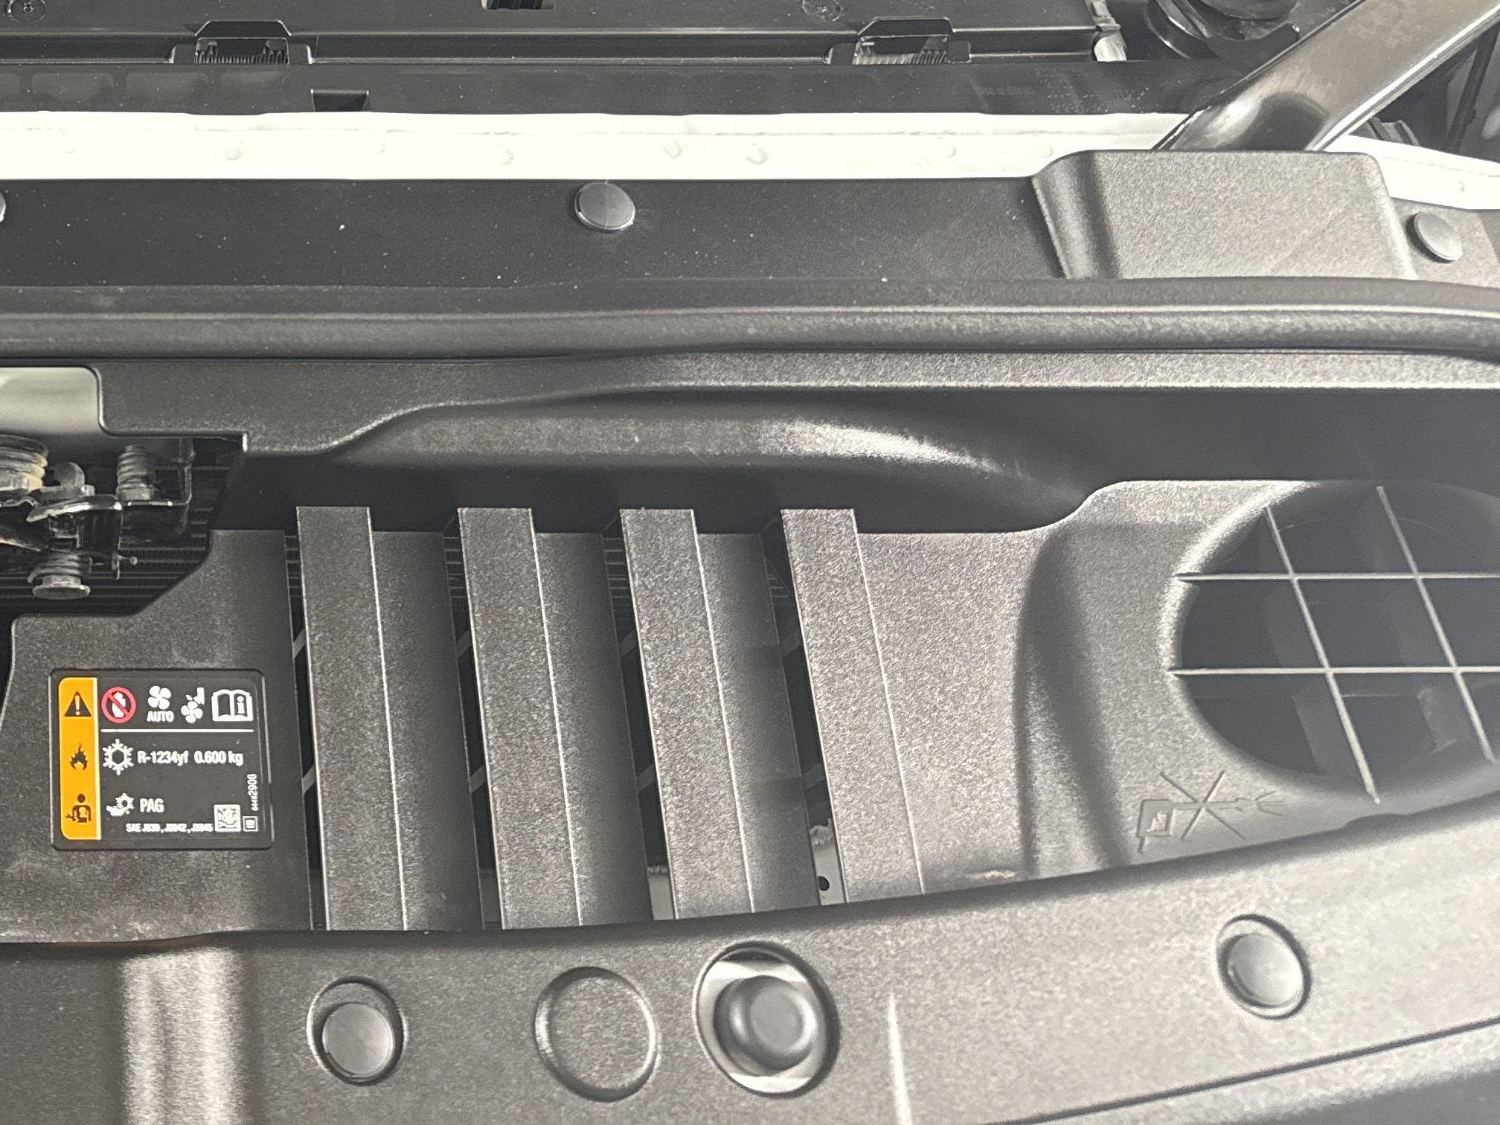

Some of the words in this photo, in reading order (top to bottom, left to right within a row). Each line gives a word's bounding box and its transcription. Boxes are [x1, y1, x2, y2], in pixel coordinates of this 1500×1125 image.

[146, 710, 174, 723] AUTO
[137, 750, 189, 766] R-1234yf
[194, 750, 226, 765] 0.600
[228, 750, 244, 767] kg
[139, 798, 165, 813] PAG
